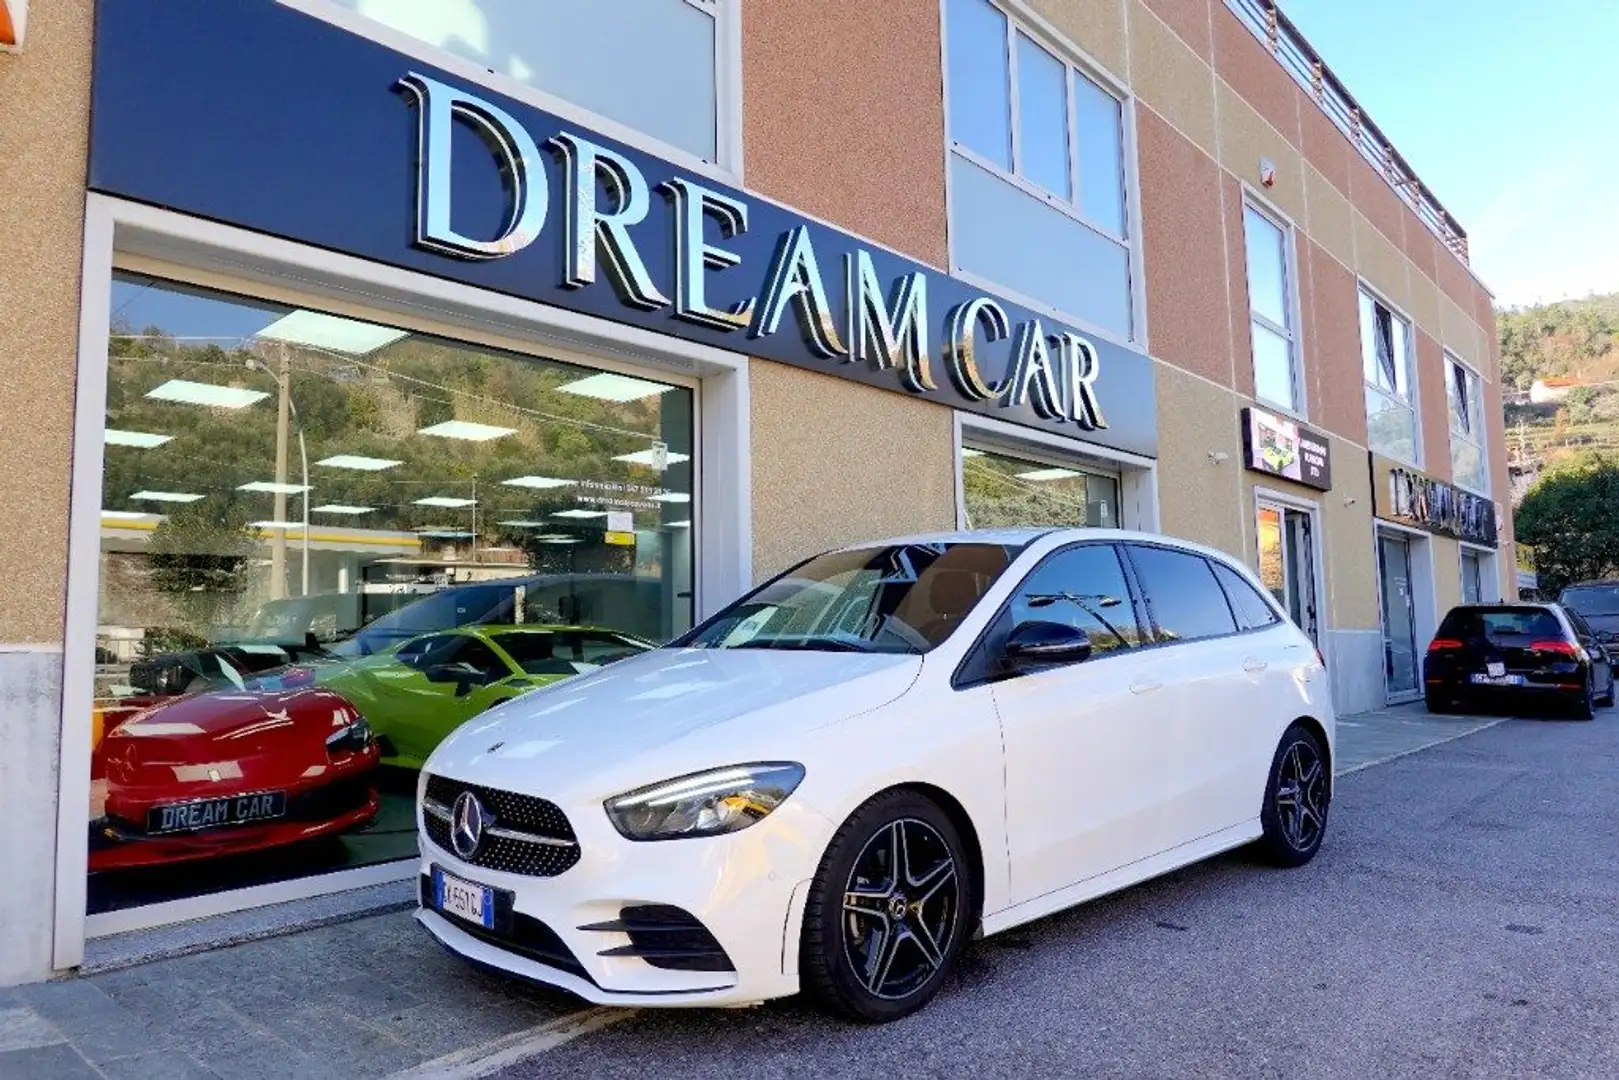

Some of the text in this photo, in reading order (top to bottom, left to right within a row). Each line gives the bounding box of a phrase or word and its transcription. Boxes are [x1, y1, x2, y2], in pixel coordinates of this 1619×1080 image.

[394, 71, 1110, 430] DREAM CAR
[161, 795, 274, 829] DREAM CAR
